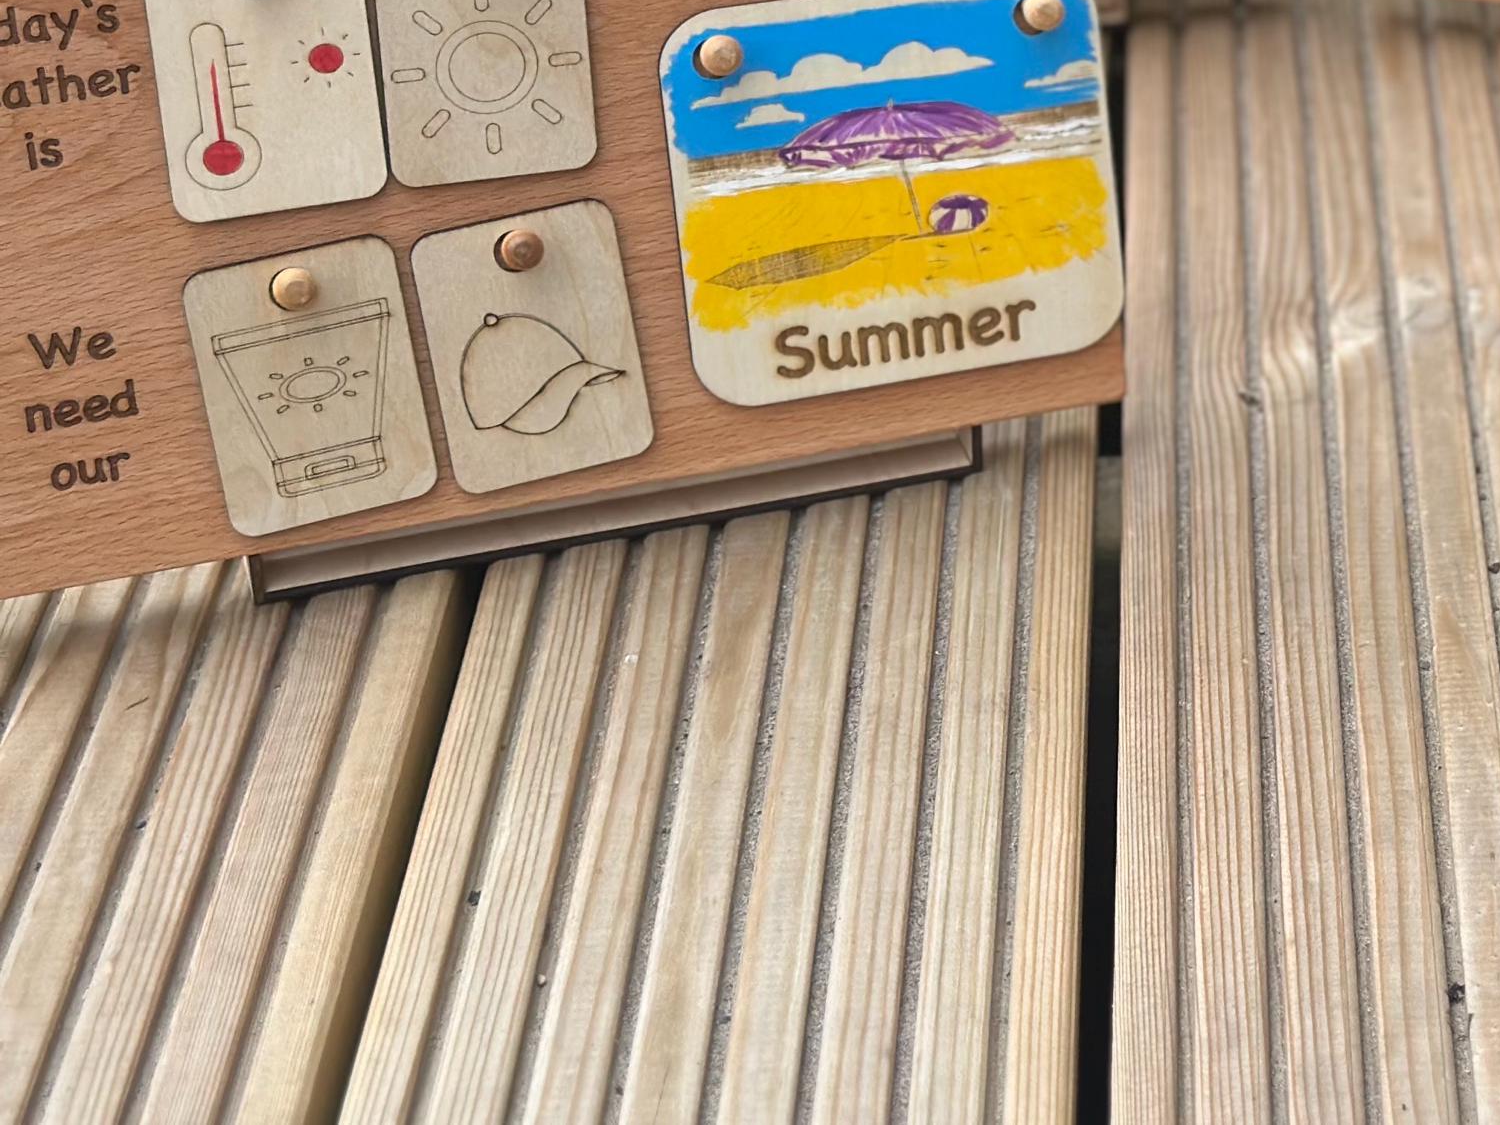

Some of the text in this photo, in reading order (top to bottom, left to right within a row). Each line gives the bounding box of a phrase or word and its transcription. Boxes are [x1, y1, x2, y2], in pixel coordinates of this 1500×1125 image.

[0, 64, 140, 109] ather
[24, 132, 63, 171] is
[27, 326, 118, 371] We
[775, 299, 1036, 380] Summer
[24, 379, 140, 434] need
[50, 450, 131, 491] our
